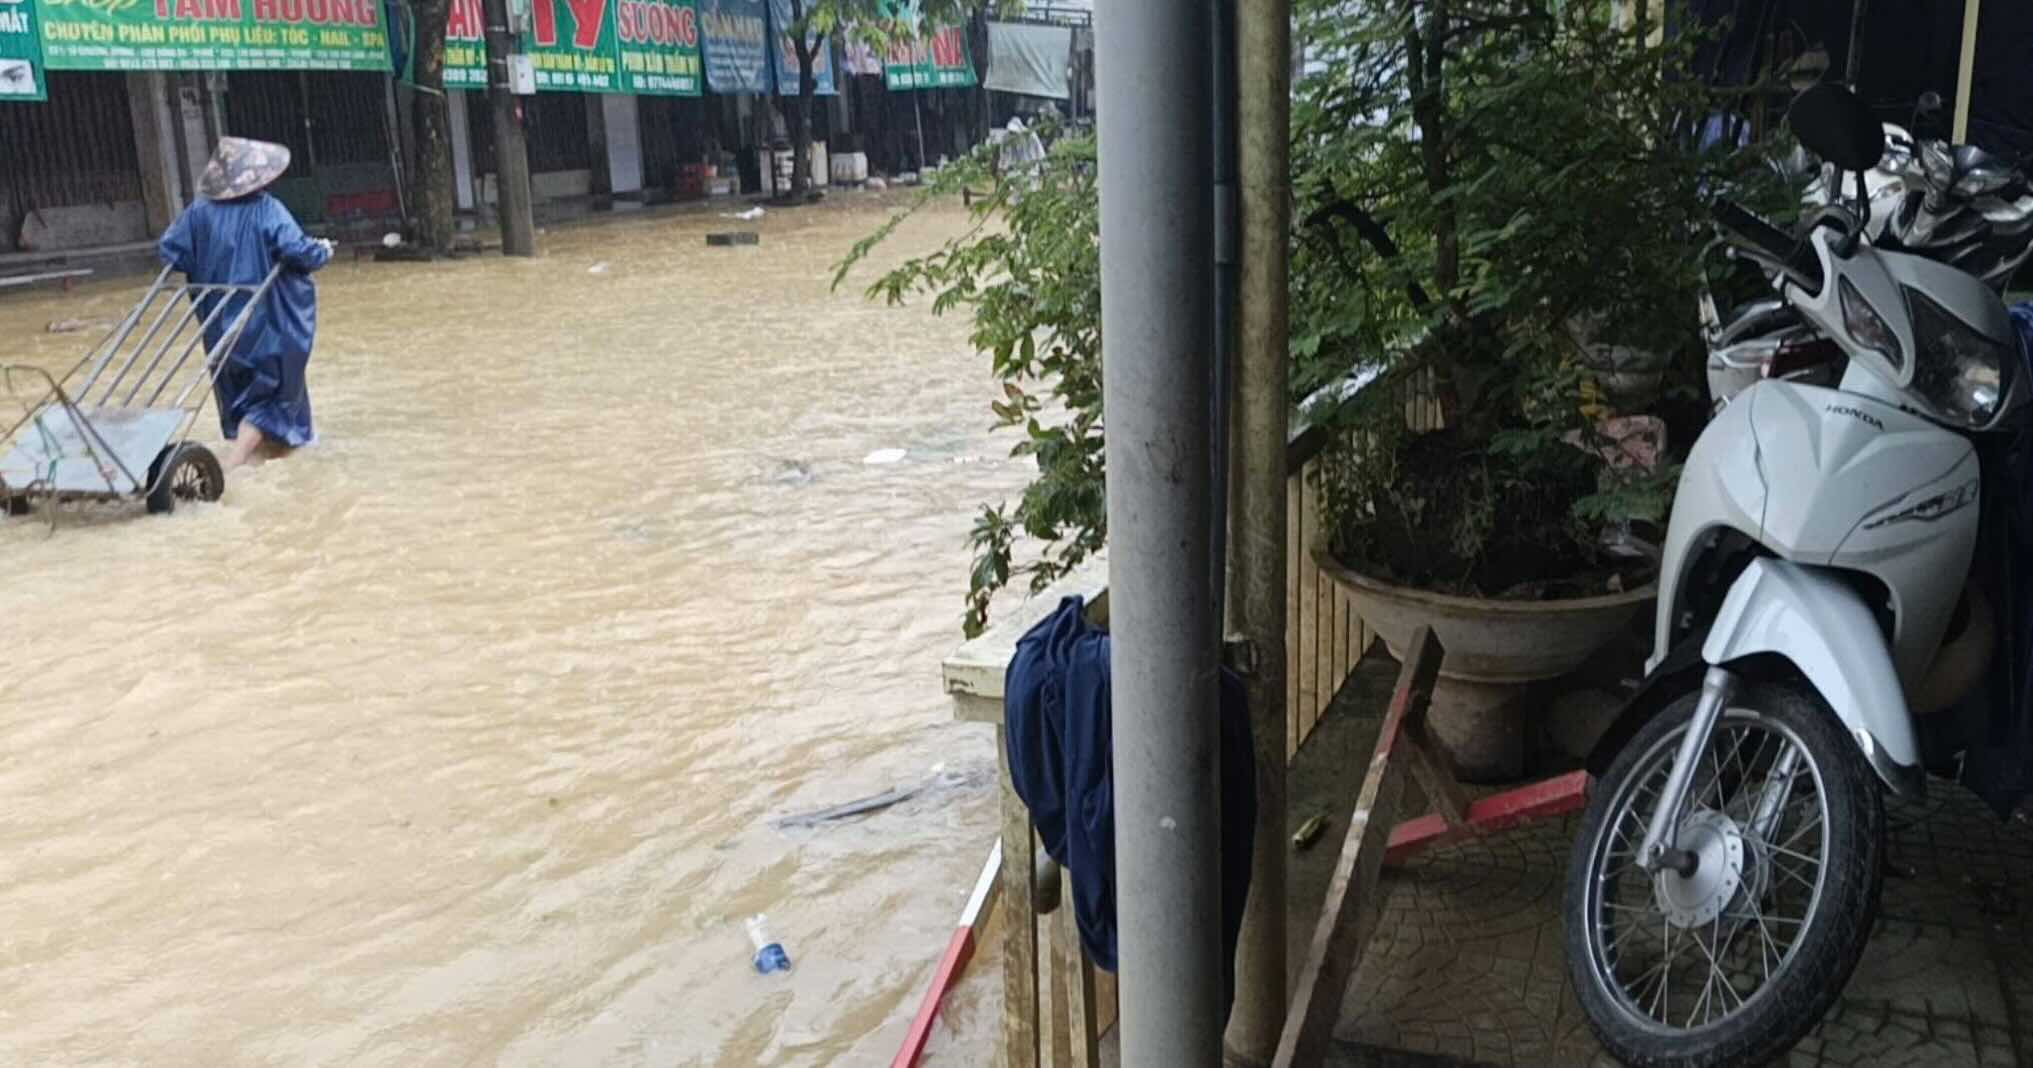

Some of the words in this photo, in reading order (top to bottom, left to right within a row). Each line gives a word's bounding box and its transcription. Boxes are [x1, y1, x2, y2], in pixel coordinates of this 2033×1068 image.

[44, 20, 113, 42] CHUYÊN
[119, 22, 164, 43] PHÂN
[169, 21, 206, 43] PHỐI
[210, 25, 240, 46] PHỤ
[281, 26, 309, 45] TÓC
[1826, 404, 1884, 431] HONDA
